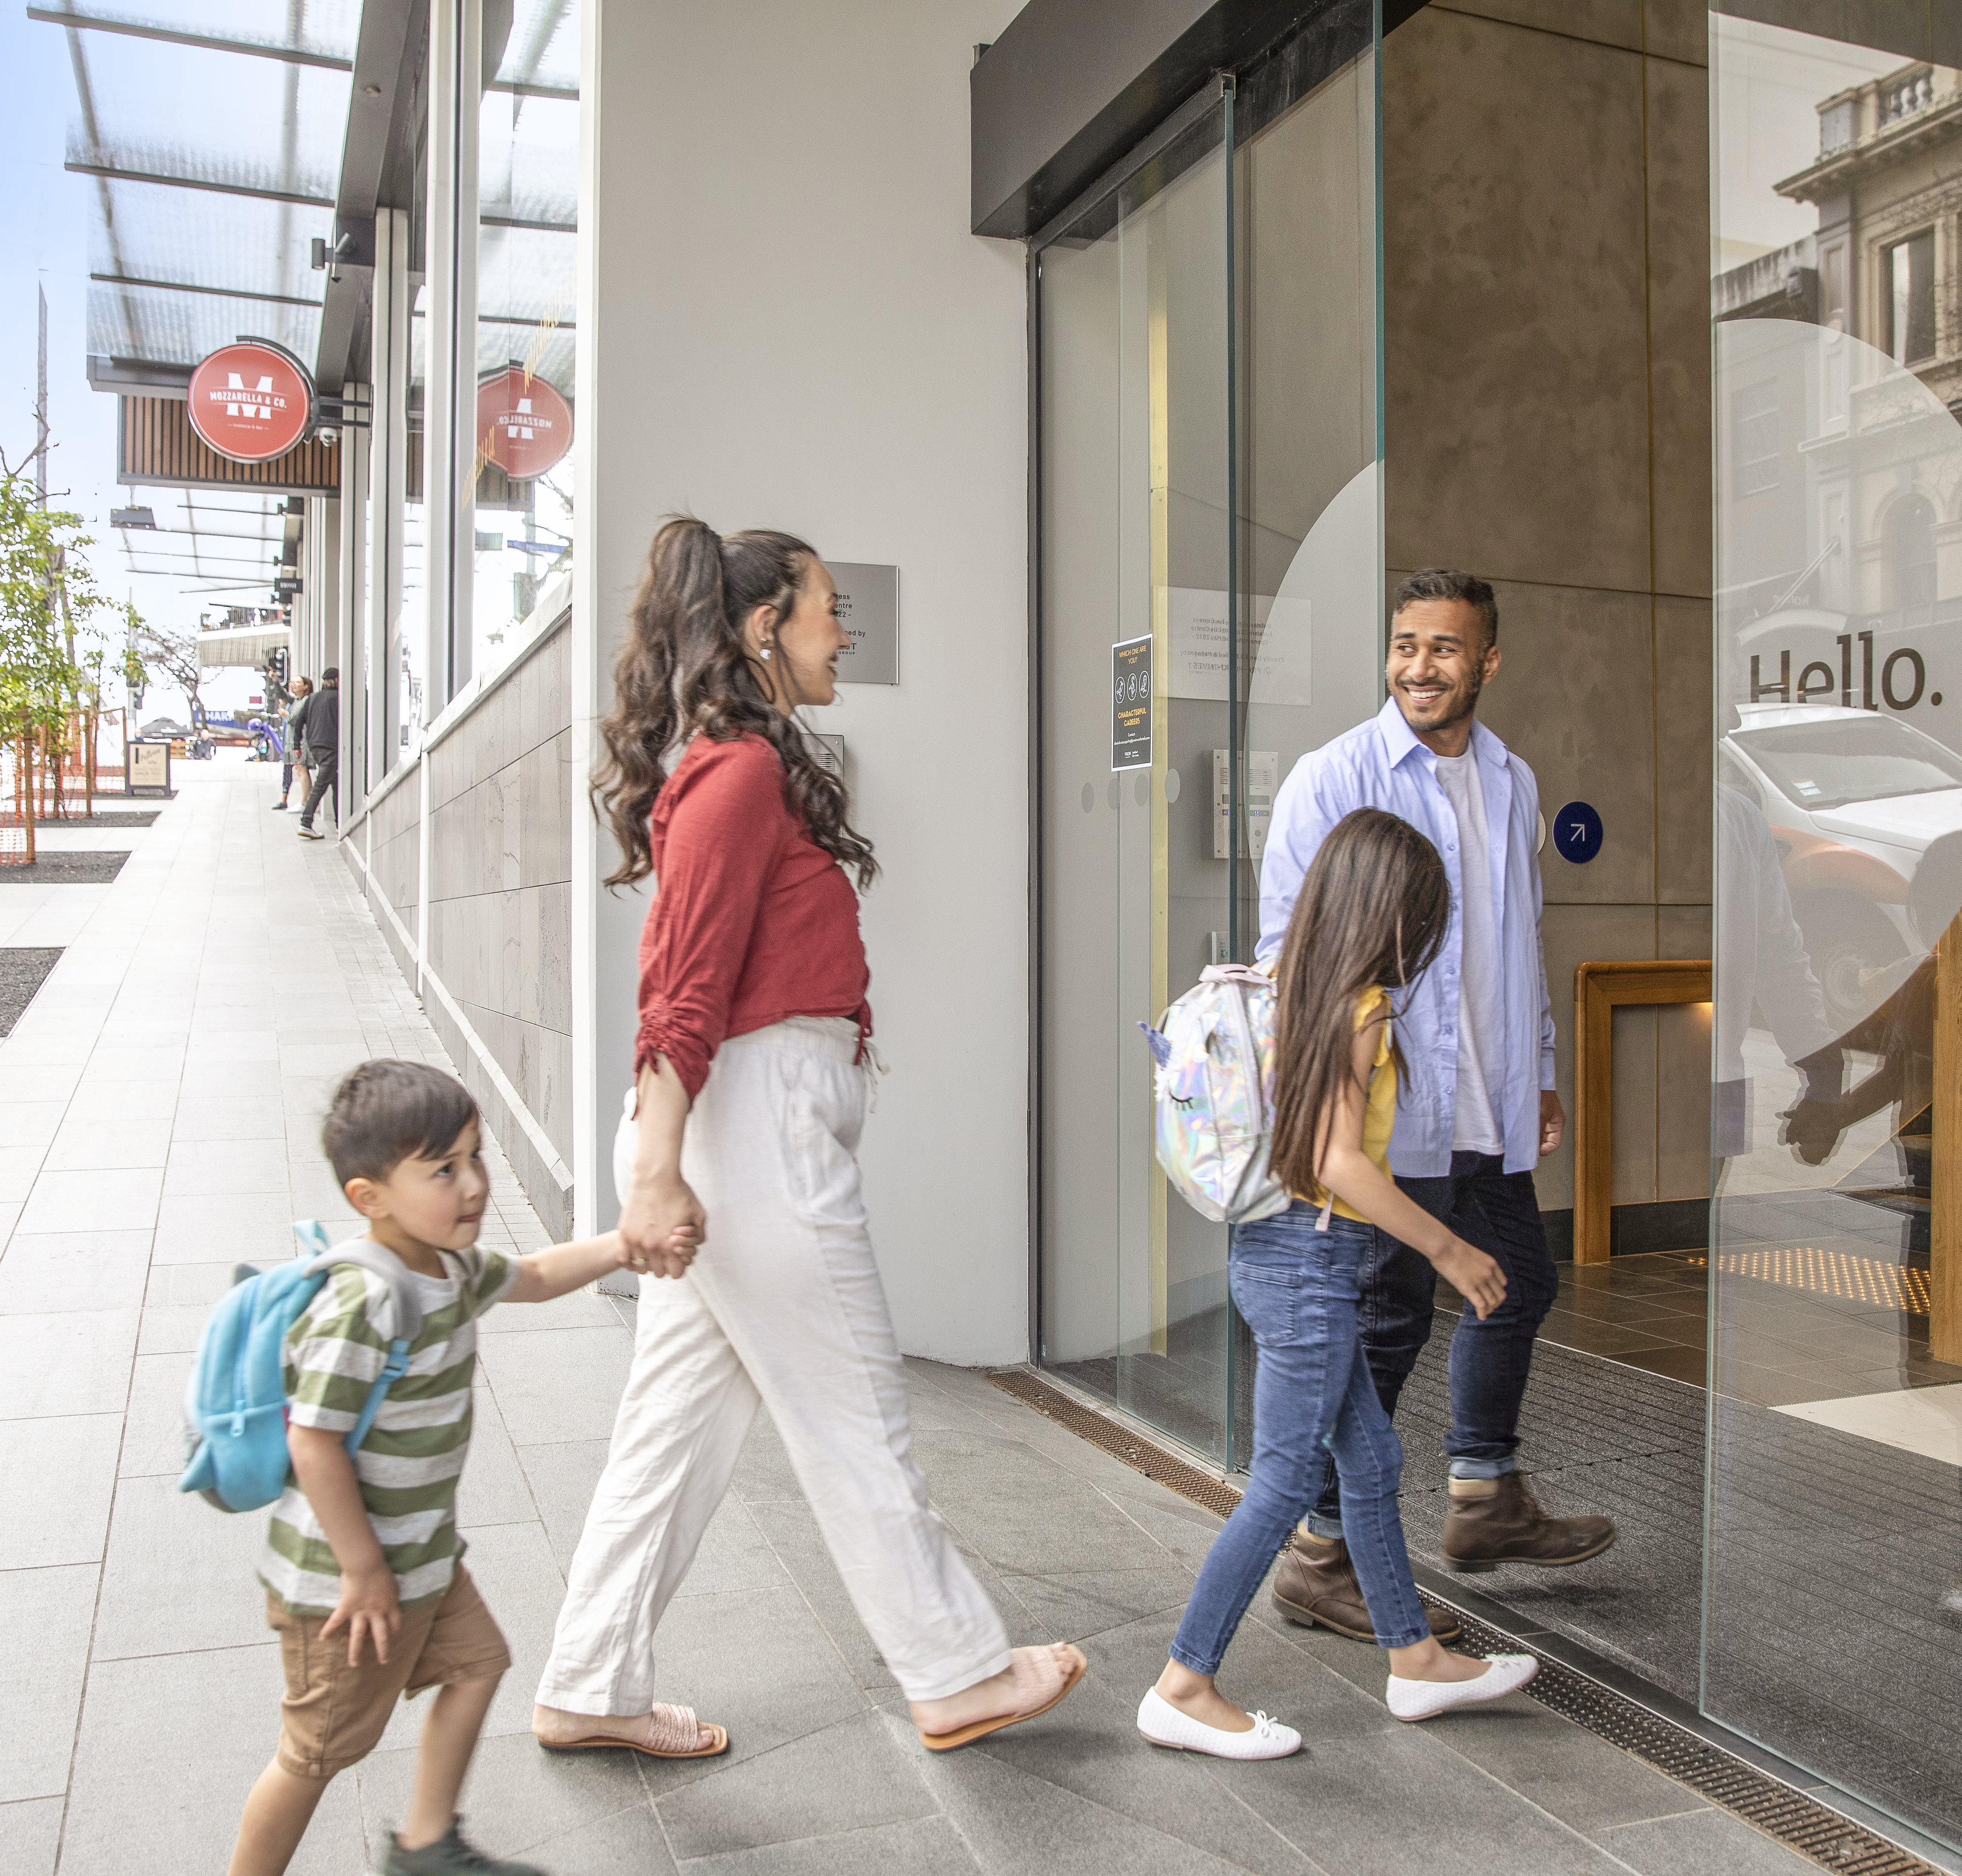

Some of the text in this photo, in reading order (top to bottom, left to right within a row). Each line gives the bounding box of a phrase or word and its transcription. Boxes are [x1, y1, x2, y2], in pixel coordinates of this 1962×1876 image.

[210, 391, 287, 408] MOZZARELLA & CO.
[226, 372, 273, 420] M
[1119, 649, 1131, 658] WHICH
[1128, 656, 1138, 664] YOU?
[1750, 629, 1943, 711] Hello.
[1118, 707, 1146, 719] CHARACTERFUL
[1123, 717, 1141, 726] CAREERS
